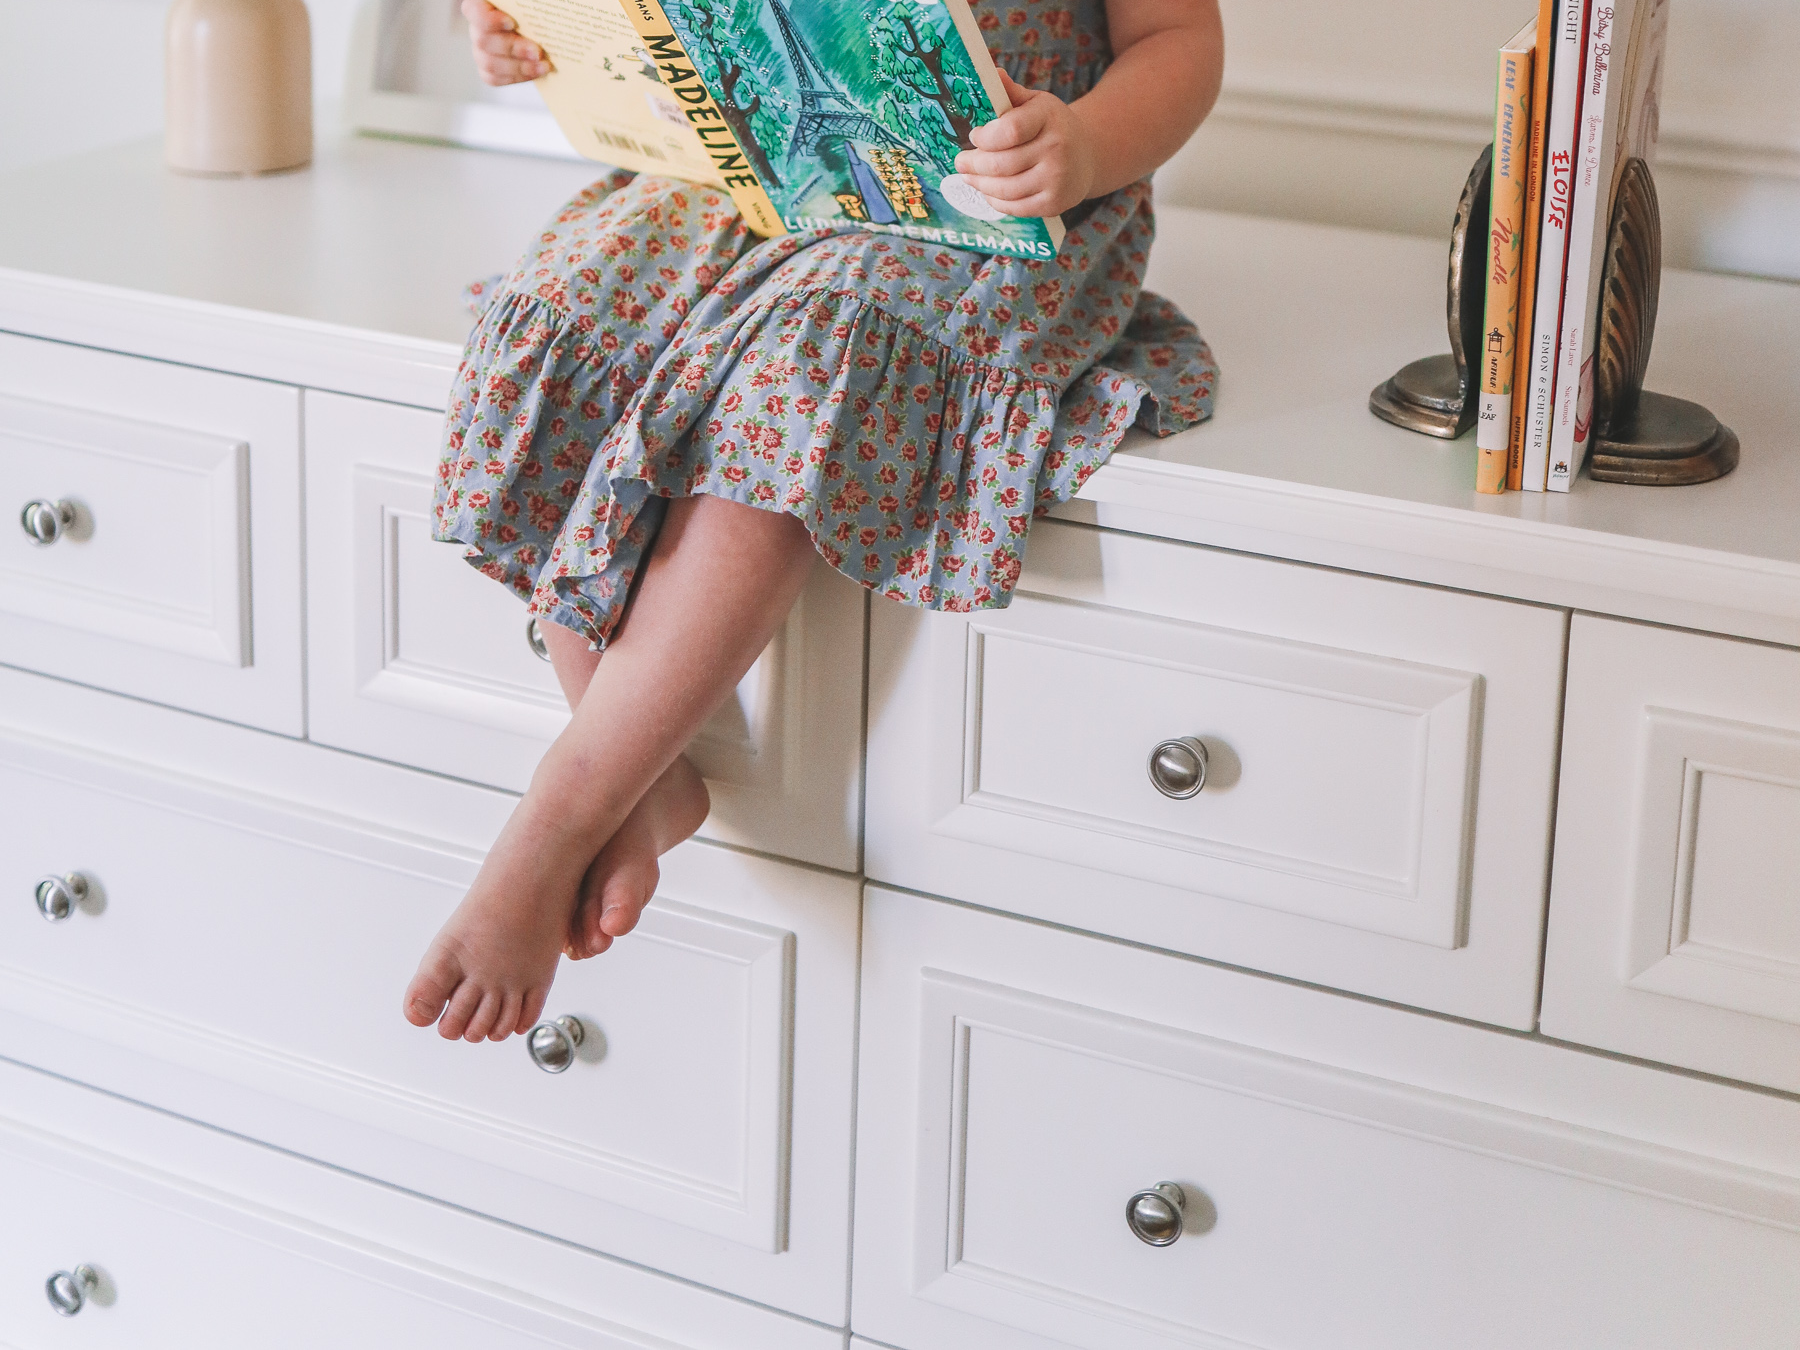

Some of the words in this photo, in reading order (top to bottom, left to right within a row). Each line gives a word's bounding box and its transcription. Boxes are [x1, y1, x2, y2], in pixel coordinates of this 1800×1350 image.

[1594, 6, 1614, 41] Bitsy
[1505, 58, 1516, 92] LEAF
[1592, 42, 1611, 97] Ballerina
[642, 33, 760, 190] MADELINE
[1499, 102, 1514, 179] BEMELMANS
[1532, 120, 1541, 162] MADELINE
[1531, 162, 1538, 171] IN
[1584, 156, 1599, 187] Dance
[1529, 171, 1537, 202] LONDON
[1548, 149, 1571, 230] ELOISE
[1491, 217, 1513, 286] Noodle
[1540, 333, 1551, 373] SIMON
[1539, 376, 1547, 384] &
[1486, 402, 1493, 412] E
[1533, 387, 1547, 449] SCHUSTER
[1514, 416, 1522, 444] PUFFIN
[1511, 445, 1520, 470] BOOKS
